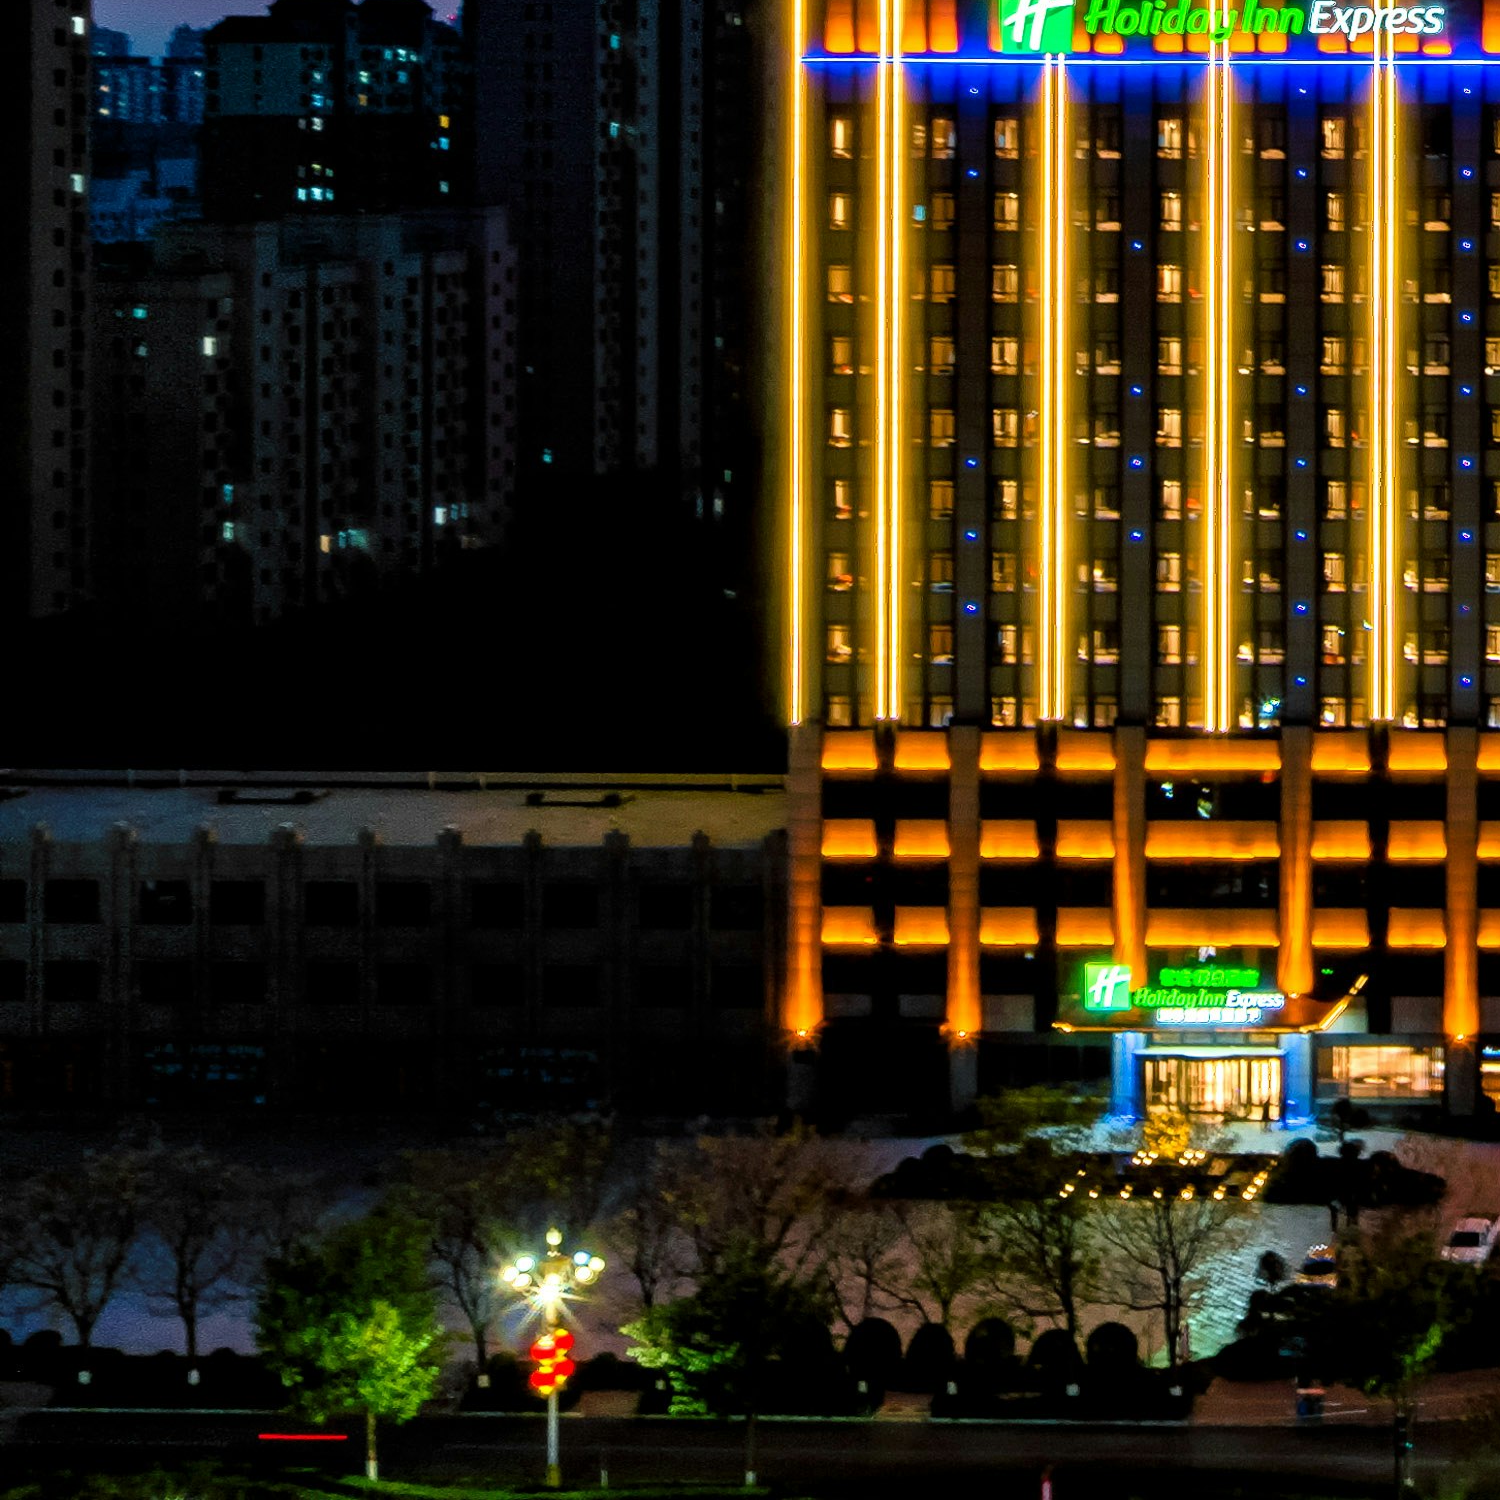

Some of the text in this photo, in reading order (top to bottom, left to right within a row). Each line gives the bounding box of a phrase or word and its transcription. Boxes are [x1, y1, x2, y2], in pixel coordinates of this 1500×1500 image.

[1307, 0, 1445, 42] Express
[1133, 988, 1285, 1010] Holiday Inn Express
